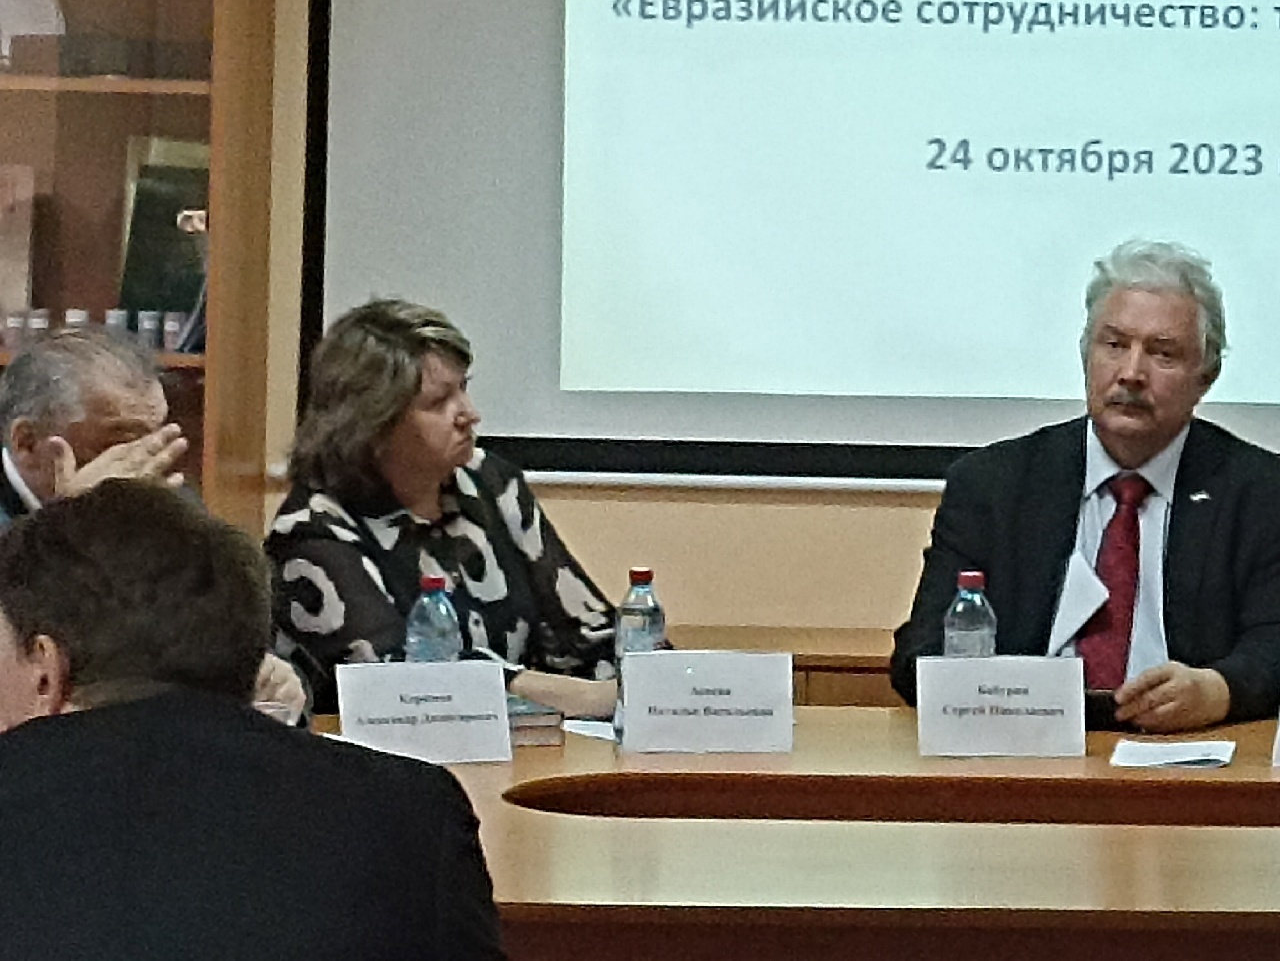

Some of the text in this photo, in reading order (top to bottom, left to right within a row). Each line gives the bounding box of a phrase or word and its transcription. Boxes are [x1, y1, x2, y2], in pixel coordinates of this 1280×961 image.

[916, 0, 1259, 34] сотрудничество:
[926, 138, 973, 171] 24
[986, 139, 1153, 181] октября
[1168, 142, 1264, 177] 2023
